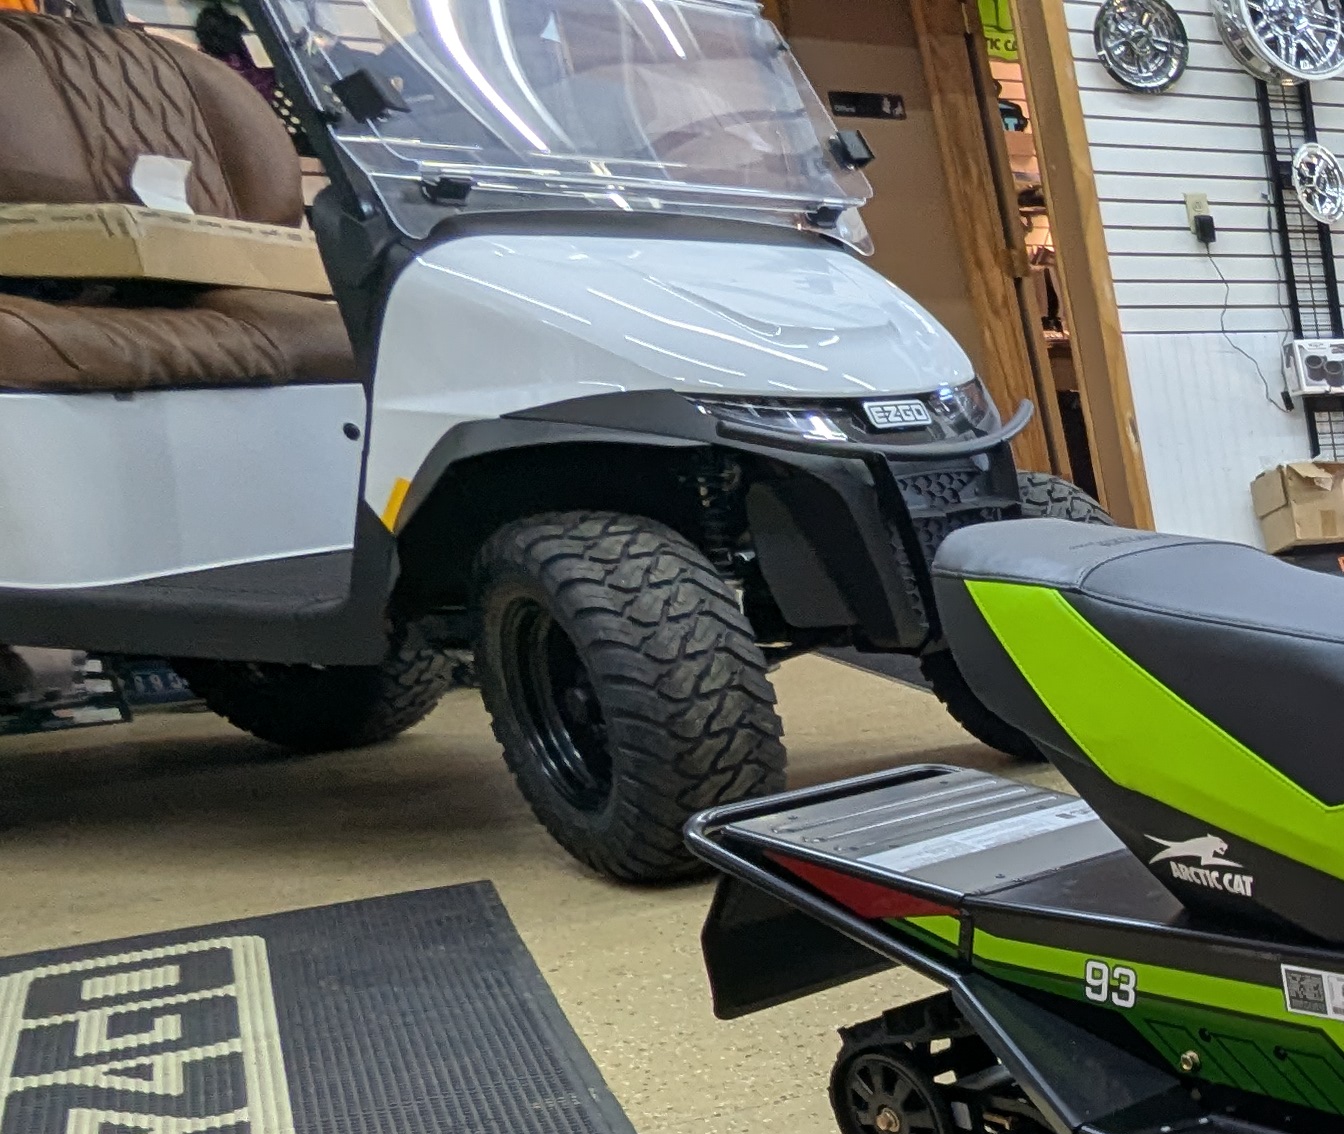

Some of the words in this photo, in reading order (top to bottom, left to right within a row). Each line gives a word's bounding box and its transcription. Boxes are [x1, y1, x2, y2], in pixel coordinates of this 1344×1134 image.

[1171, 860, 1224, 891] ARCTIC
[1224, 872, 1254, 898] CAT
[1085, 959, 1138, 1008] 93
